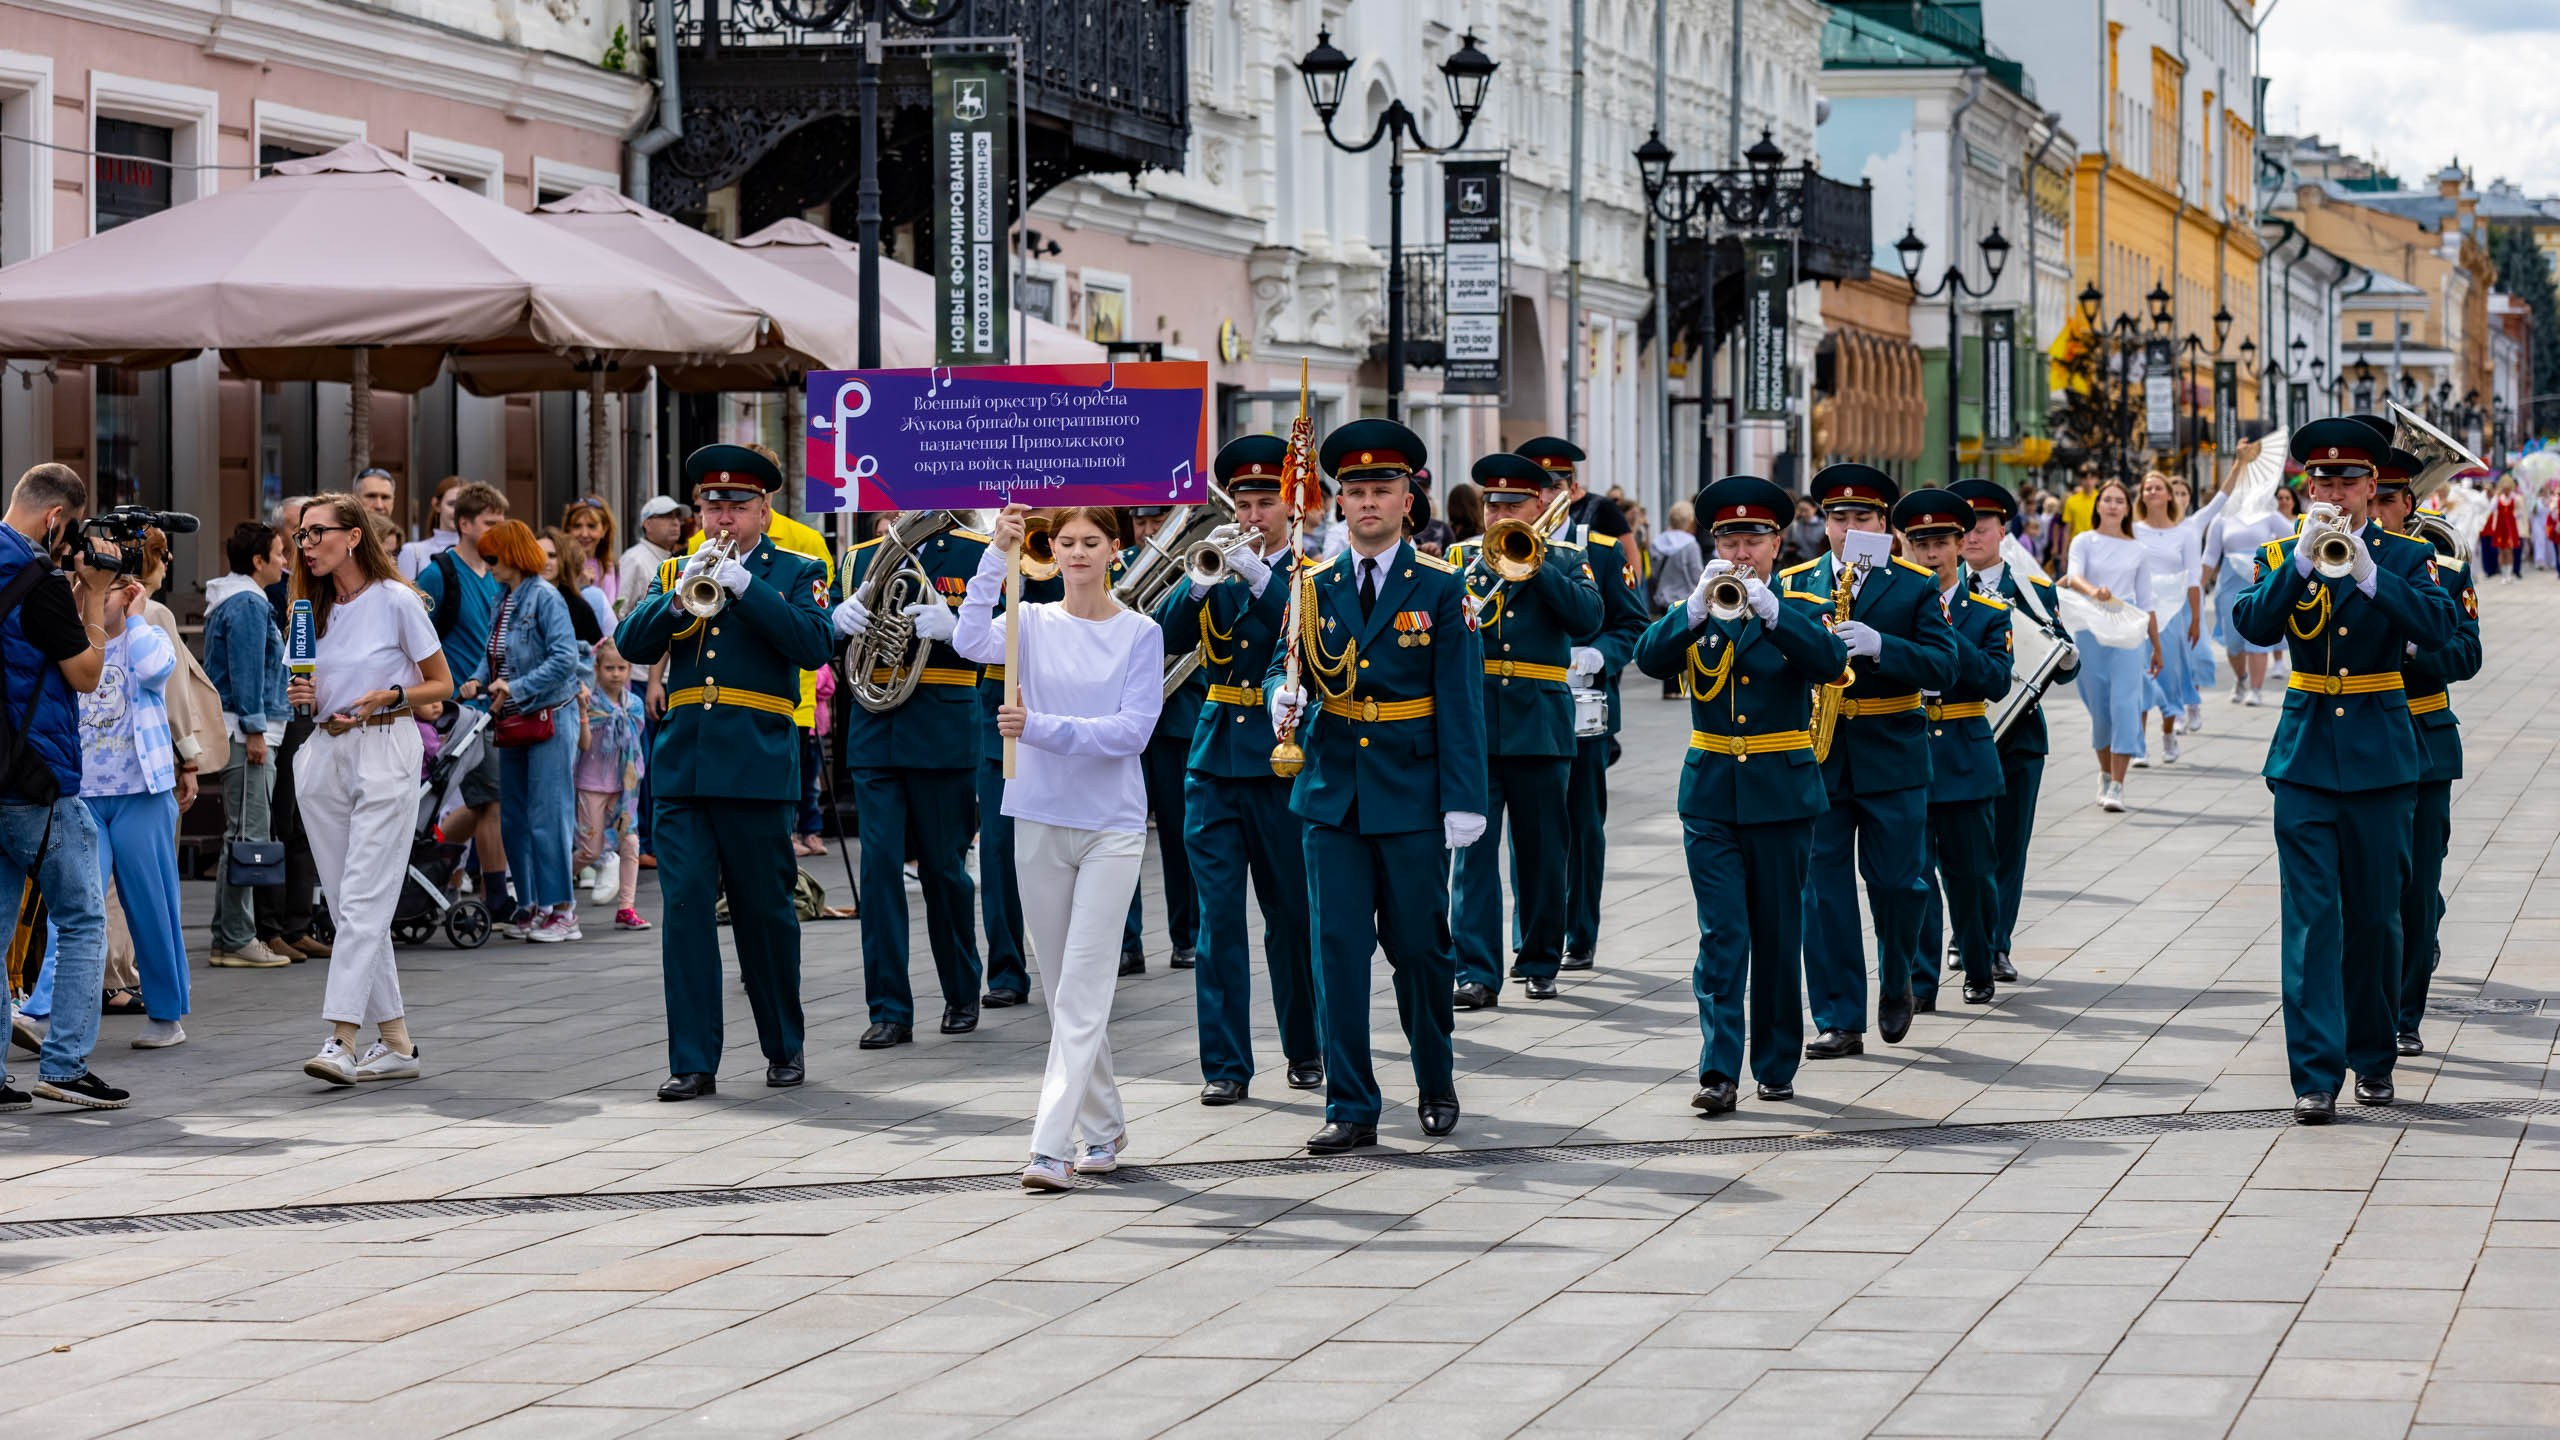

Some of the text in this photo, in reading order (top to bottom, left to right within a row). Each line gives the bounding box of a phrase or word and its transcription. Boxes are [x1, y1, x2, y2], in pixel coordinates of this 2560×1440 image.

[977, 138, 988, 236] СЛУЖУВНН.РФ
[950, 132, 965, 353] НОВЫЕ ФОРМИРОВАНИЯ
[978, 249, 989, 271] 017
[978, 275, 989, 289] 17
[978, 294, 989, 308] 10
[978, 312, 989, 336] 800
[1757, 290, 1769, 410] НИЖЕГОРОДСКОЕ
[1771, 327, 1784, 411] ОПОЛЧЕНИЕ
[914, 395, 981, 411] Военный
[984, 397, 1047, 412] оркестр
[1073, 390, 1128, 411] ордена
[900, 412, 1140, 434] Жукова бригады оперативного
[920, 434, 1125, 452] назначения Приволжского
[914, 453, 1126, 475] округа войск национальной
[979, 473, 1066, 491] гвардии РФ
[296, 613, 307, 657] ПОЕХАЛИ!
